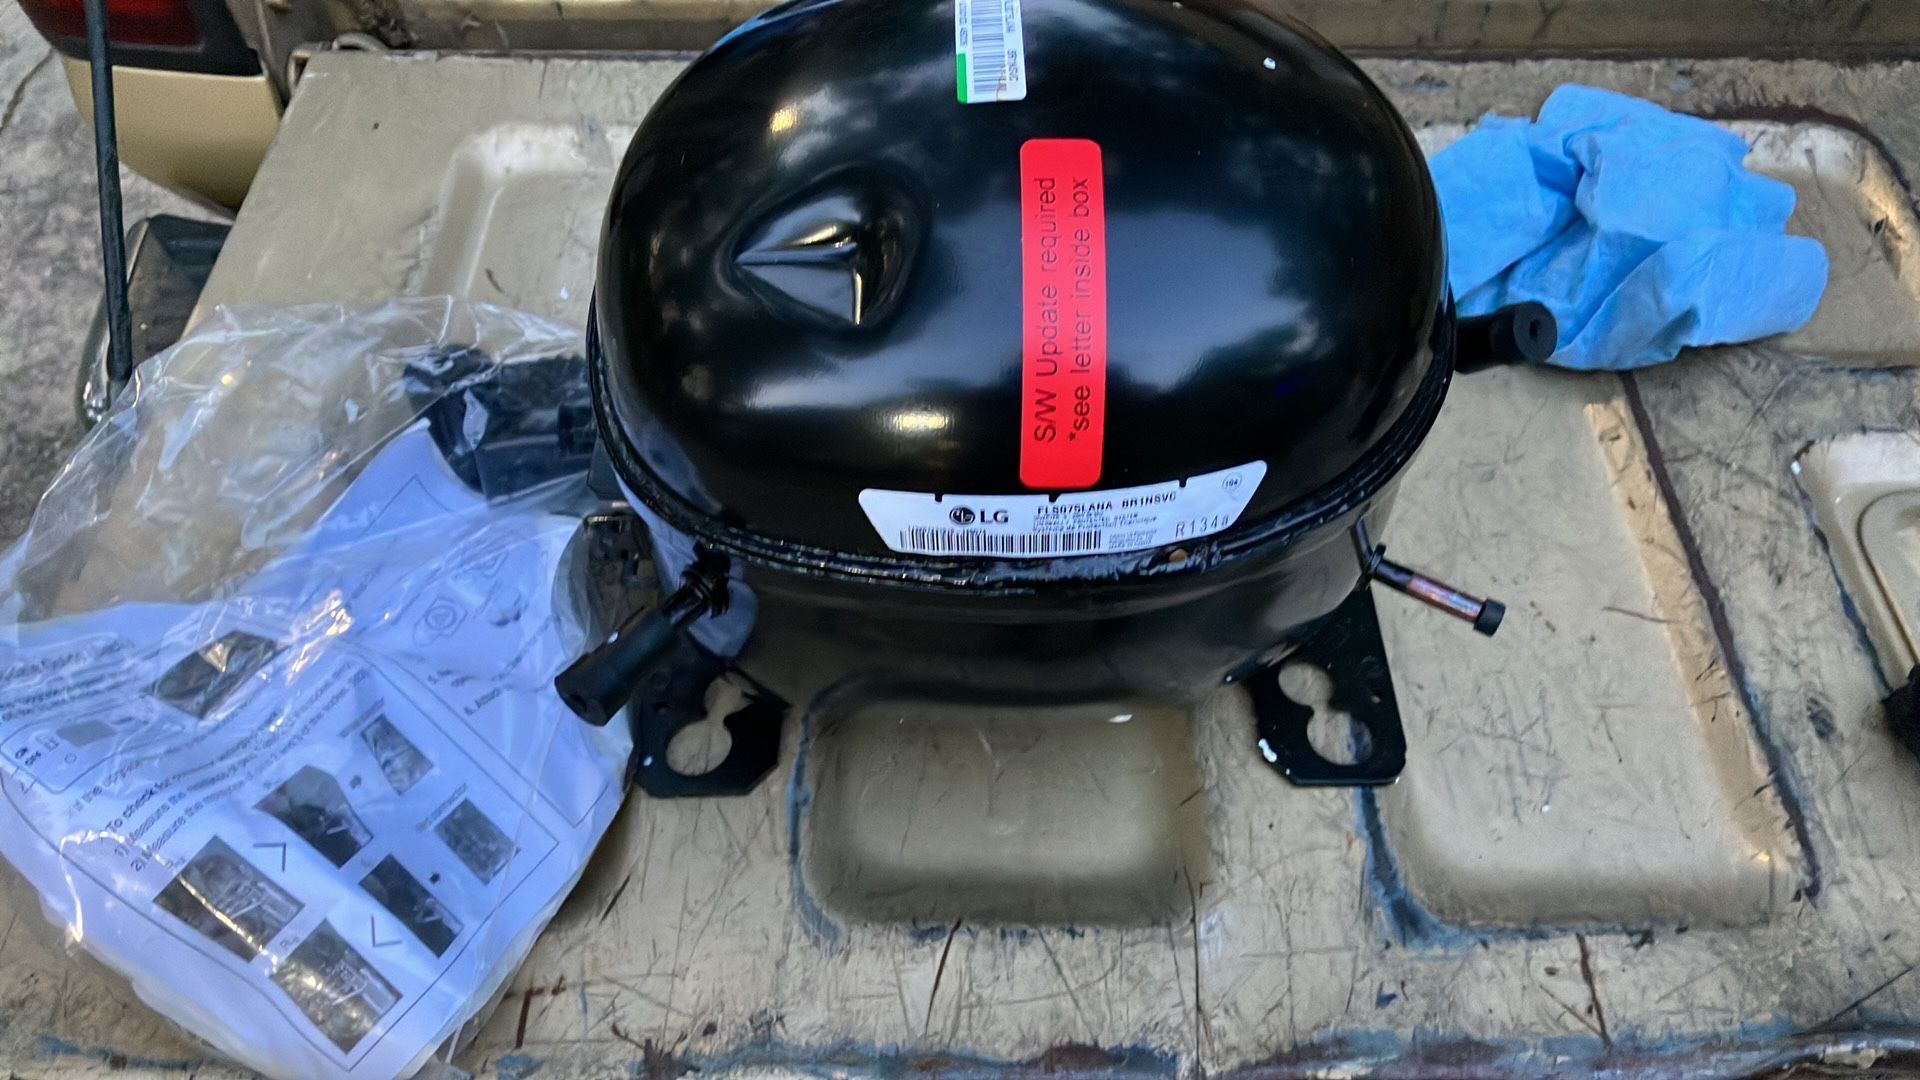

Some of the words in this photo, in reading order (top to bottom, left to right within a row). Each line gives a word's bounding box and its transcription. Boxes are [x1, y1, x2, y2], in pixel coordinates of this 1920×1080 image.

[1034, 177, 1064, 273] required
[1068, 177, 1090, 219] box
[1069, 229, 1091, 299] inside
[1035, 285, 1062, 377] Update
[1069, 309, 1091, 374] letter
[1034, 388, 1056, 443] S/W
[980, 508, 1009, 524] LG
[1175, 514, 1230, 538] R134a
